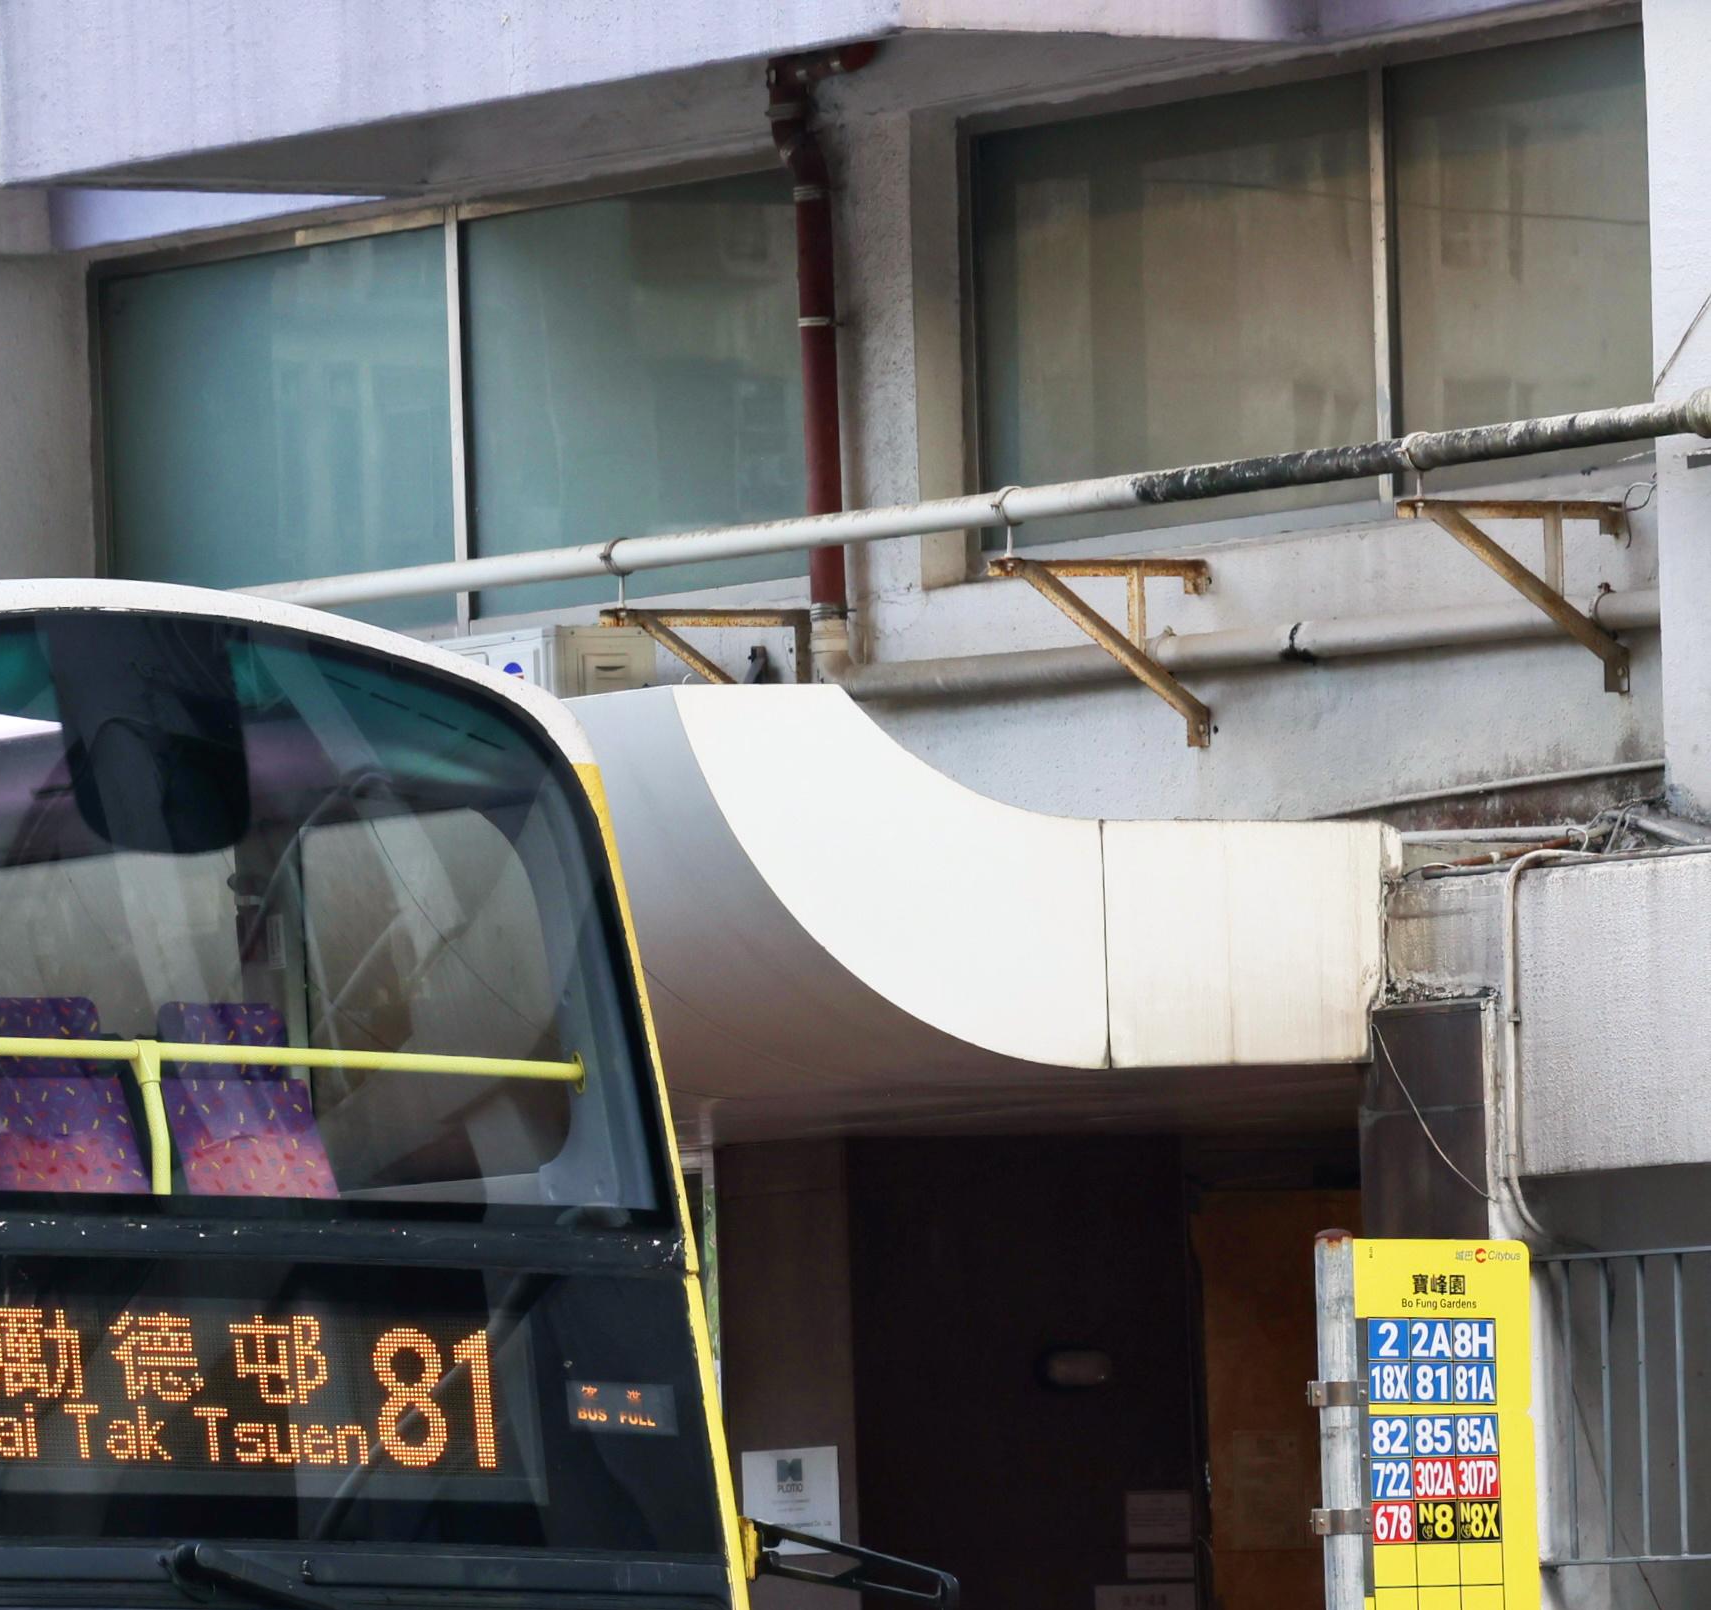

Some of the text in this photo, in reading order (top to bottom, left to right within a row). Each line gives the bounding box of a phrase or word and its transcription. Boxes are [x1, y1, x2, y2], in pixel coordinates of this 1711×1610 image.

[1488, 1250, 1521, 1261] Citybus
[1412, 1274, 1466, 1295] 寶峰園
[1401, 1298, 1477, 1310] Bo Fung Gardens
[1378, 1322, 1494, 1358] 2 2A 8H
[373, 1327, 497, 1468] 81
[1371, 1365, 1495, 1400] 18X 81 81A
[577, 1408, 608, 1421] BUS
[63, 1403, 173, 1460] Tak
[193, 1406, 369, 1465] Tsuen
[1372, 1417, 1497, 1454] 82 85 85A
[1372, 1460, 1497, 1497] 722 302A 307P
[1375, 1505, 1412, 1540] 678
